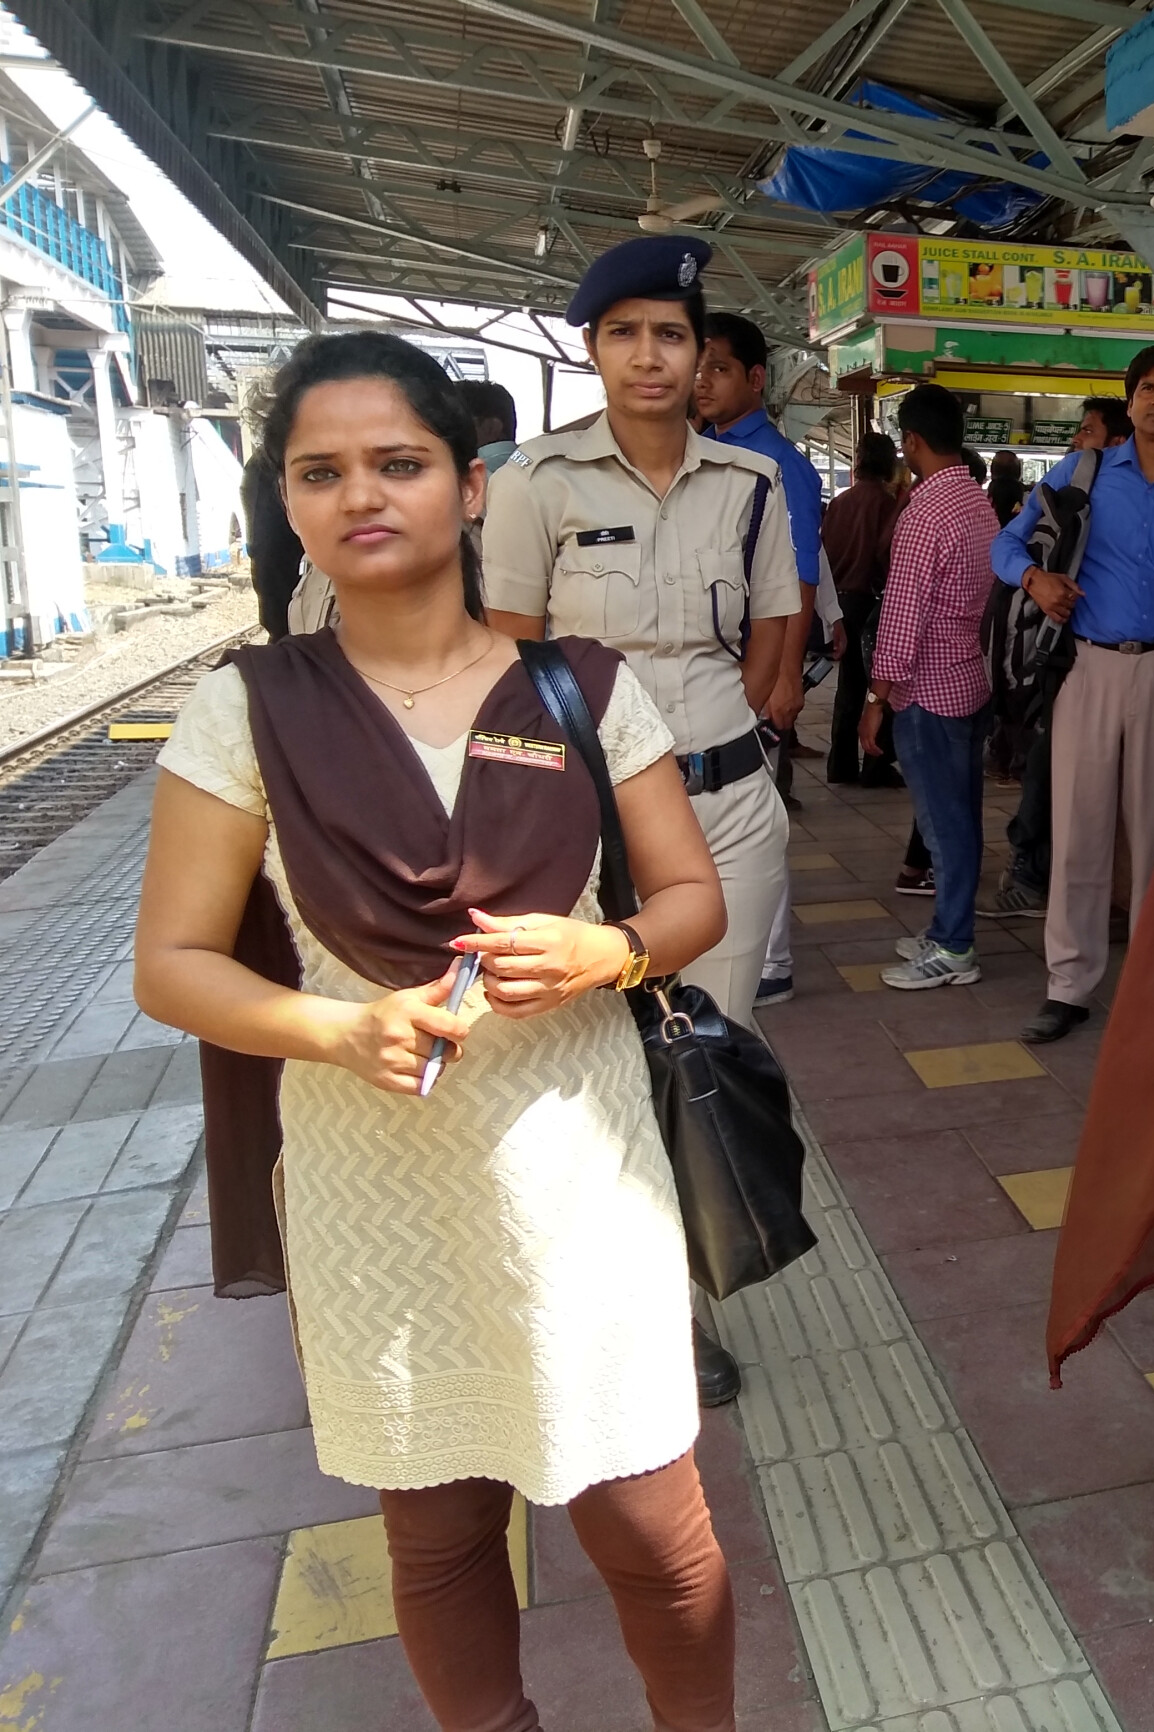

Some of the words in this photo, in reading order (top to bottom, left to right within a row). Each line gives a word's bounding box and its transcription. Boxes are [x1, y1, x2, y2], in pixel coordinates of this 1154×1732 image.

[922, 247, 959, 258] JUICE
[962, 249, 999, 260] STALL
[1053, 251, 1071, 265] S.
[1076, 253, 1095, 266] A.
[1102, 254, 1148, 268] IRAN
[510, 450, 530, 467] RPF
